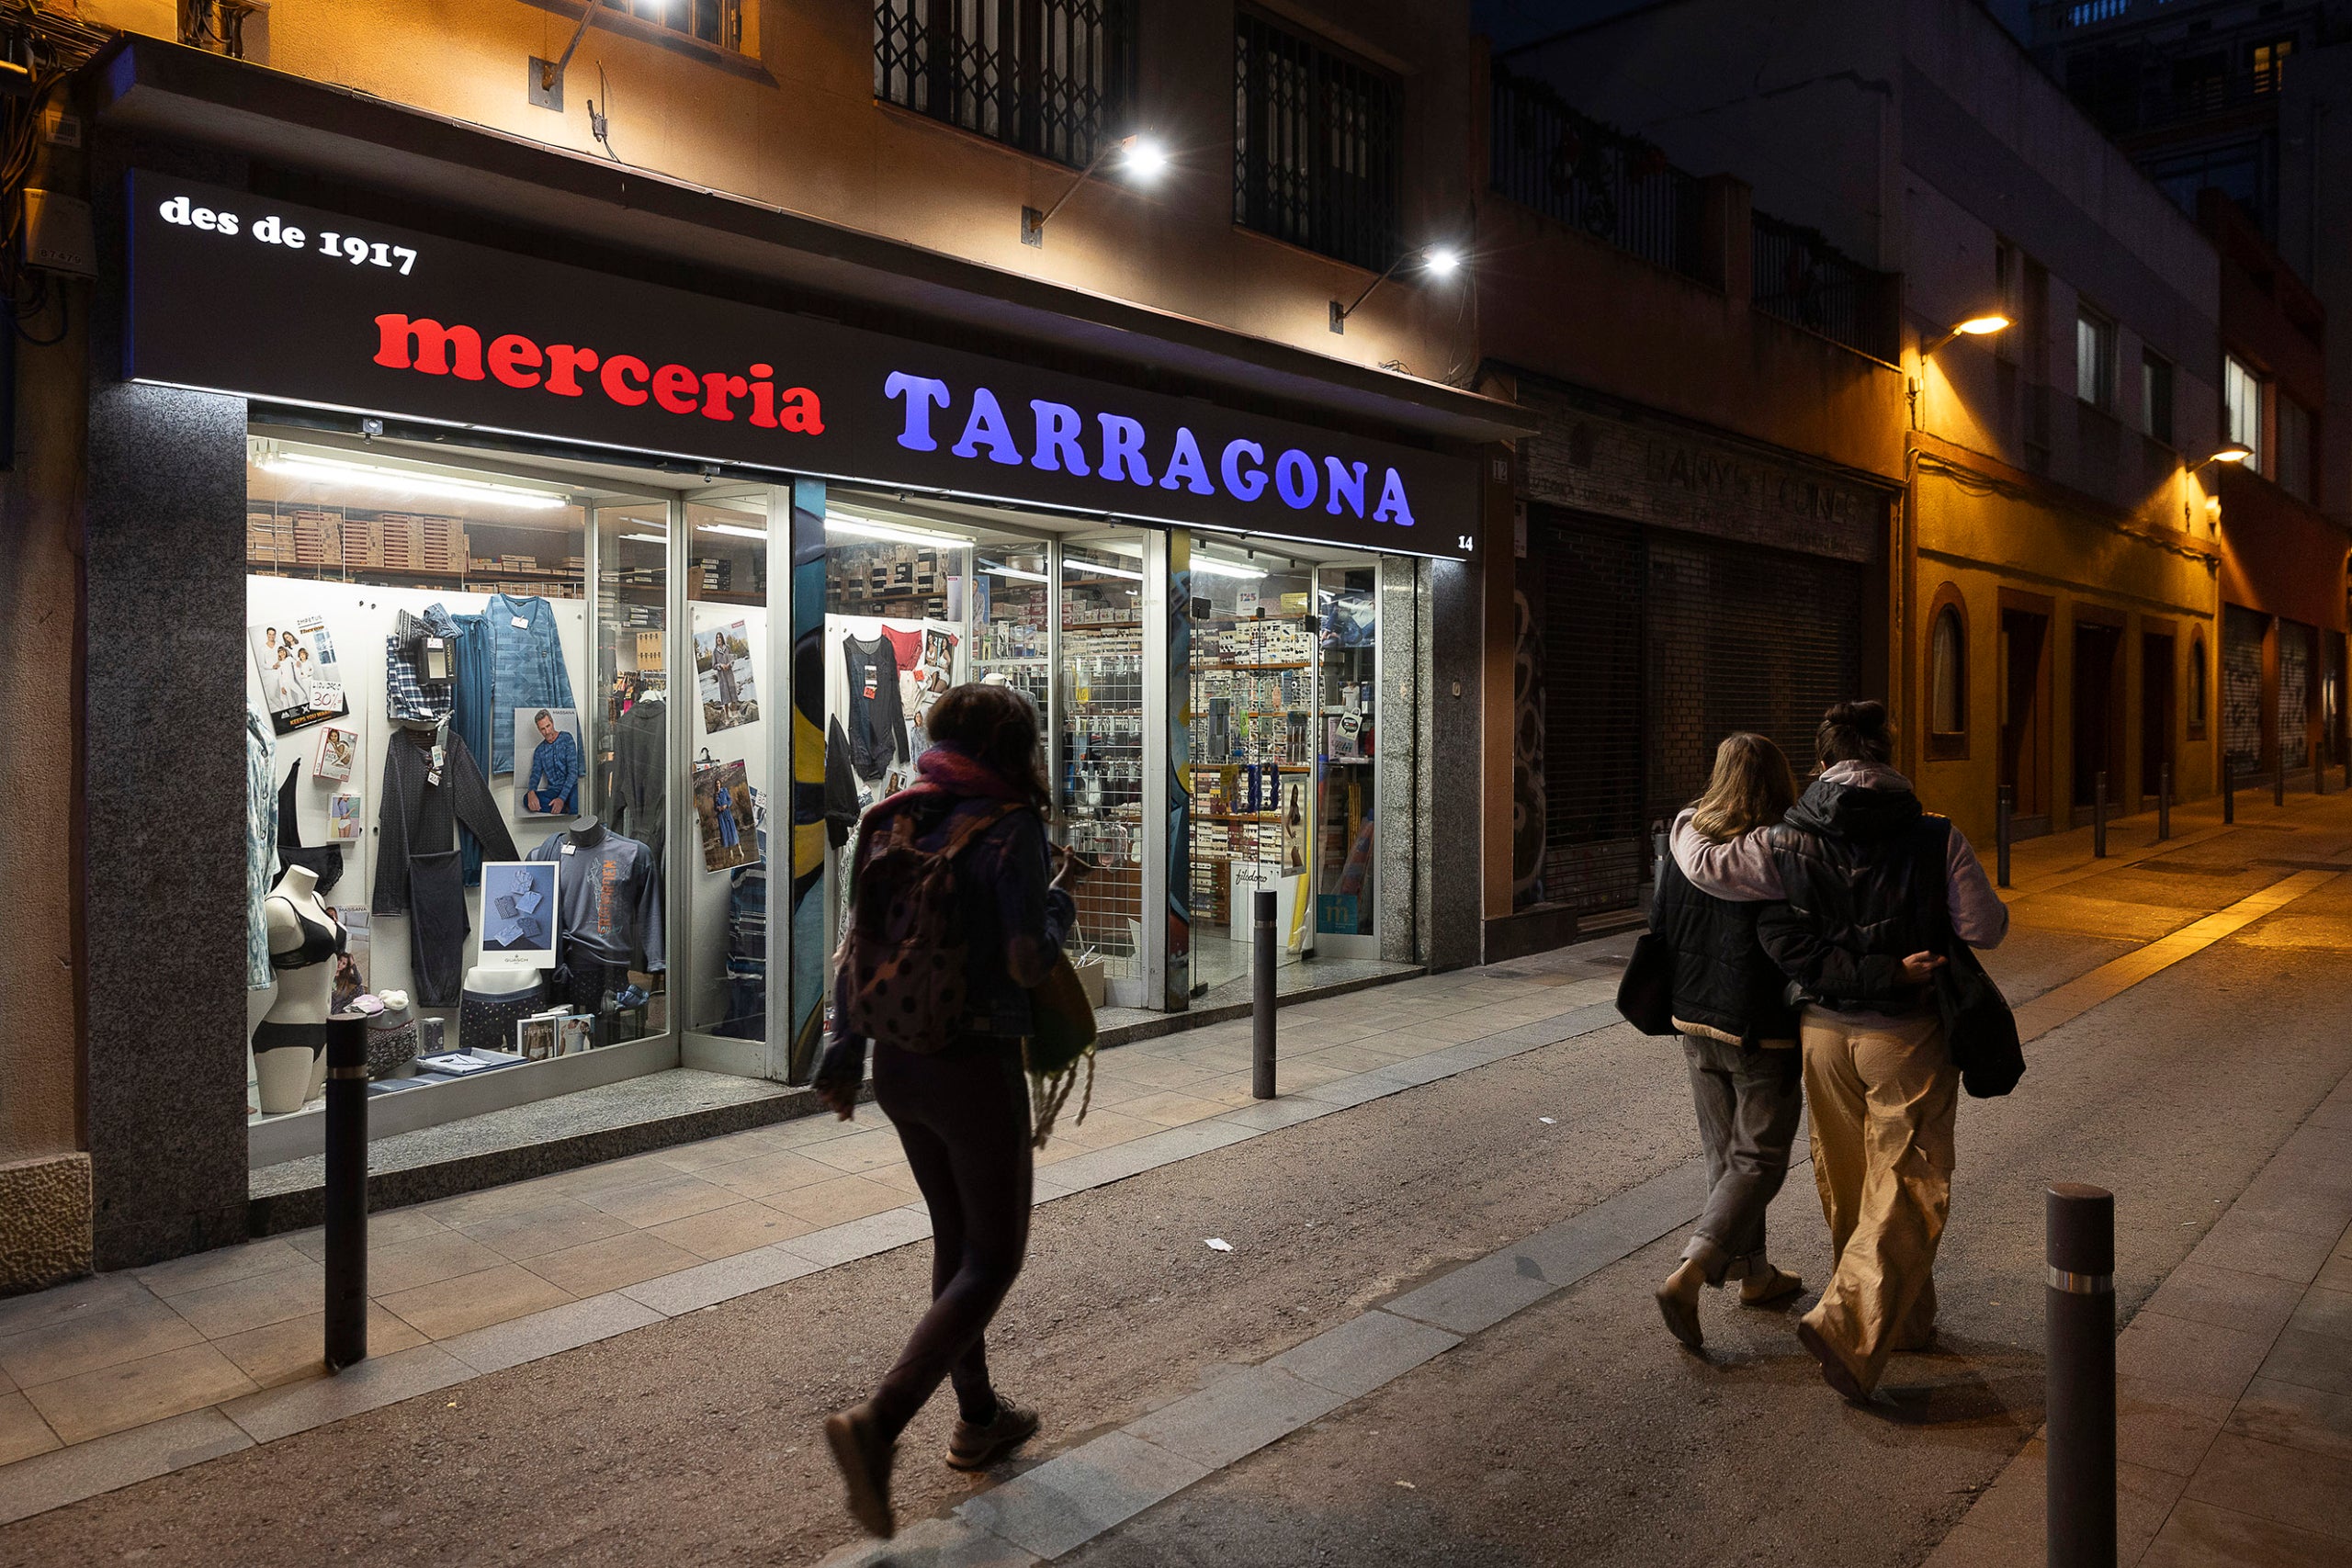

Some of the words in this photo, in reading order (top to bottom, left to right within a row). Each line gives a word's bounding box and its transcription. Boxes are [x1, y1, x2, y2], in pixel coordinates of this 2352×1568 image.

[160, 197, 239, 235] des
[252, 215, 305, 249] de
[319, 231, 417, 276] 1917
[374, 314, 826, 436] merceria
[885, 371, 1415, 526] TARRAGONA
[1494, 461, 1507, 479] 12
[1646, 440, 1750, 495] BANYS
[1459, 536, 1474, 552] 14
[1239, 592, 1257, 602] 125
[524, 1027, 553, 1036] IMPETUS
